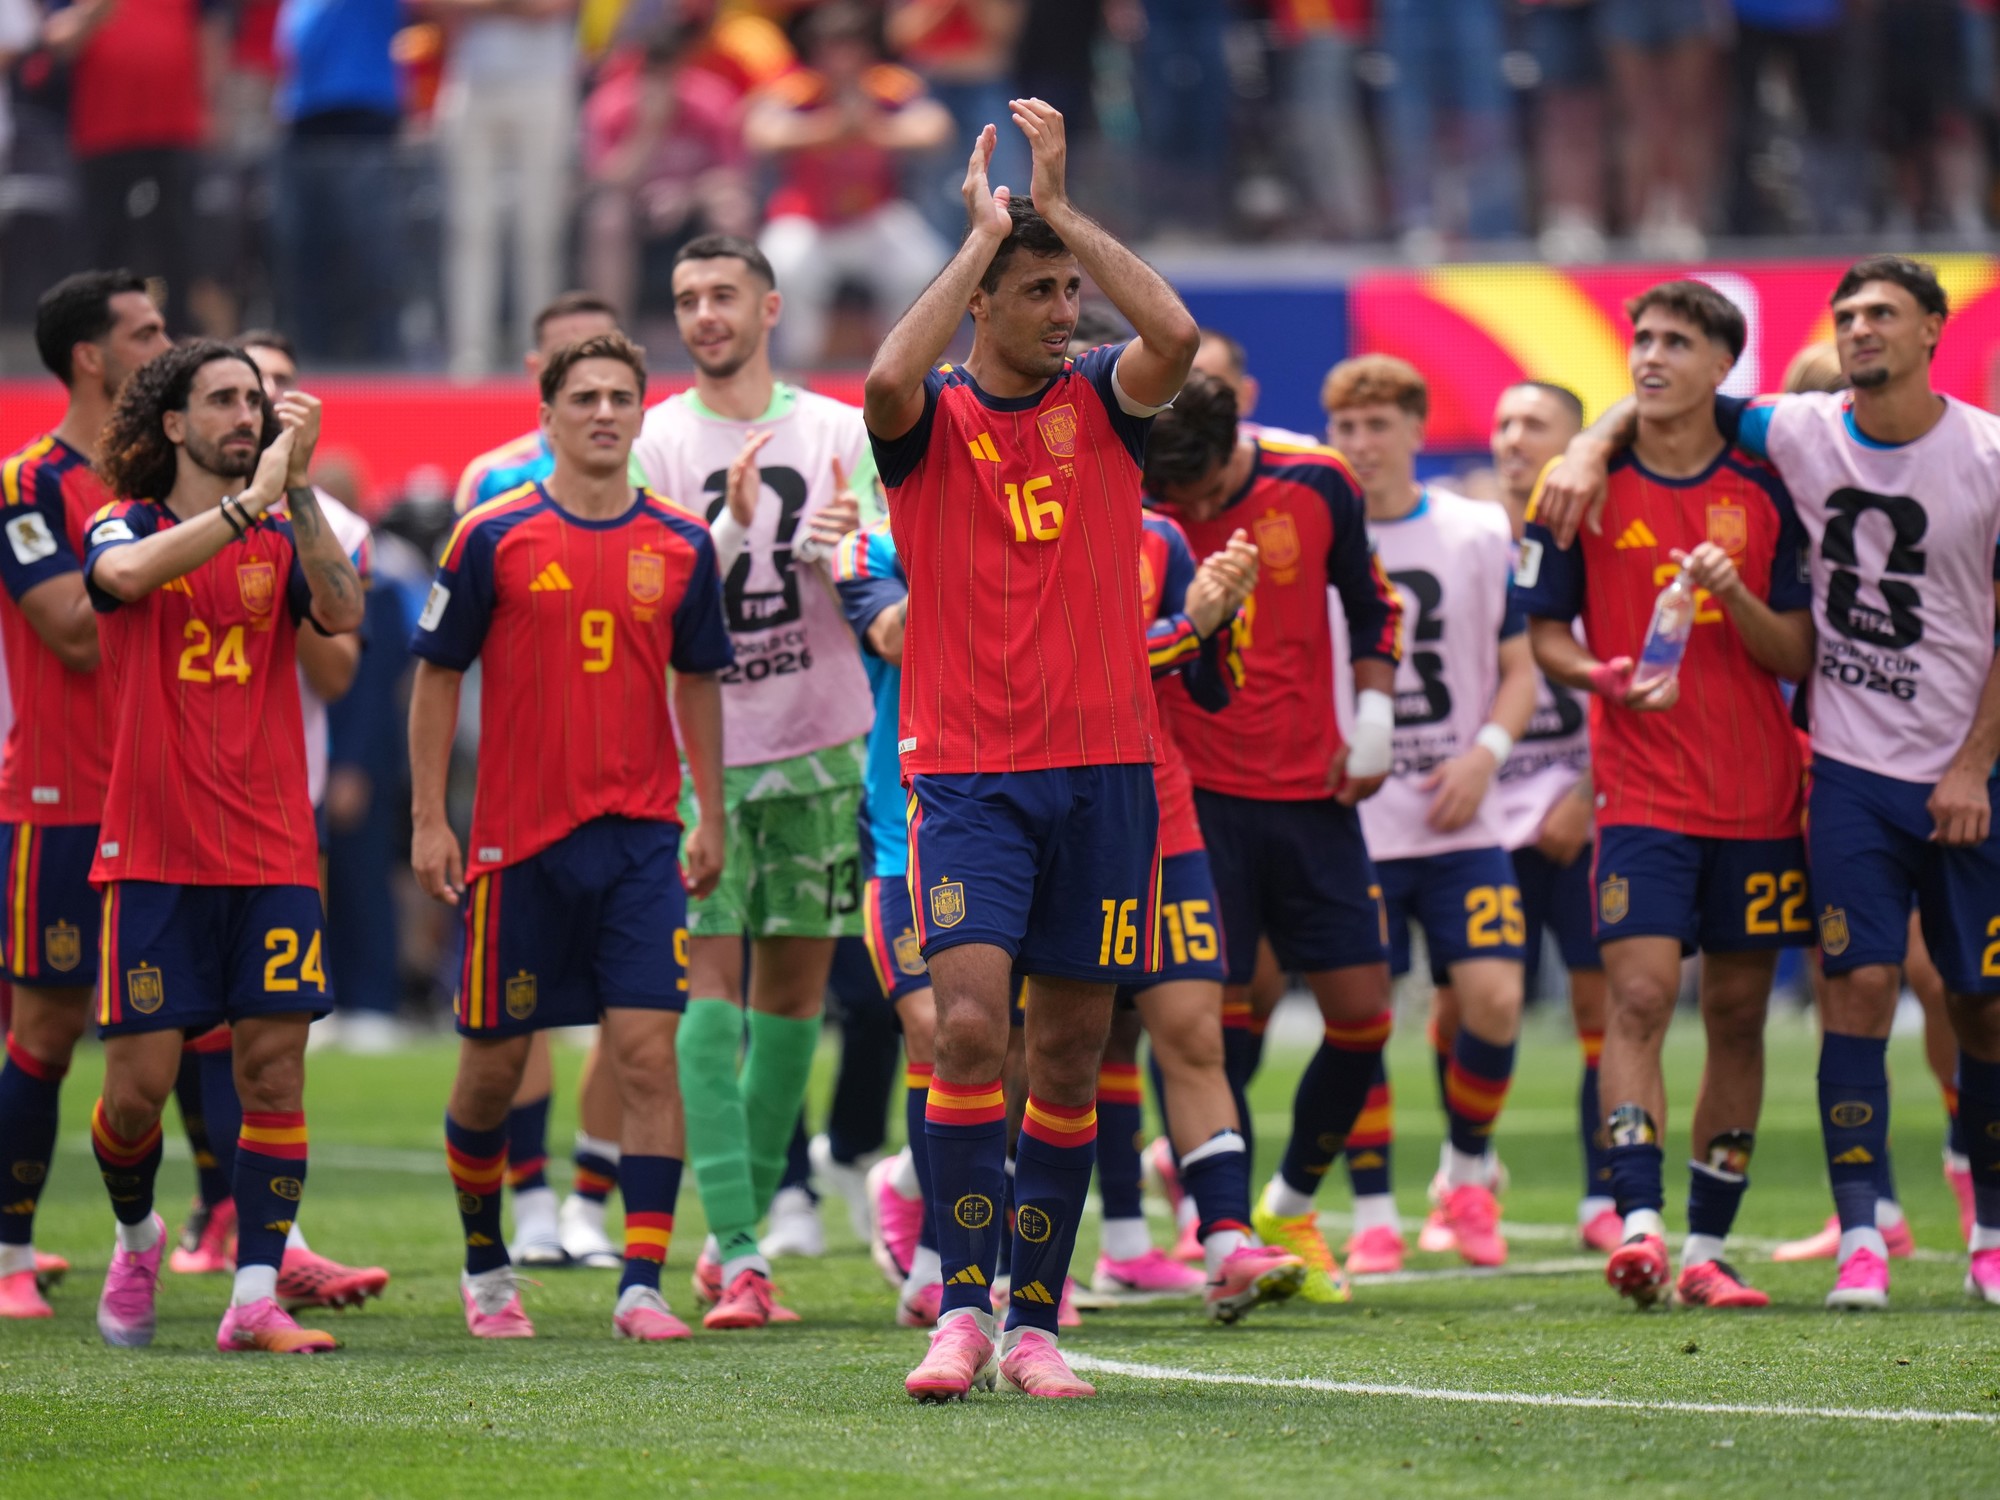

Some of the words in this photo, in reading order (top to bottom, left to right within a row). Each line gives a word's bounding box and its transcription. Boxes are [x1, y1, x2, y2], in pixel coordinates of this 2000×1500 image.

[1004, 475, 1064, 542] 16
[178, 618, 252, 685] 24
[580, 609, 615, 673] 9
[1847, 608, 1897, 637] FIFA
[1821, 655, 1918, 701] 2026
[1883, 655, 1922, 674] CUP
[826, 856, 859, 919] 13
[1465, 884, 1526, 948] 25
[1745, 869, 1811, 935] 22
[263, 927, 326, 993] 24
[1099, 898, 1138, 966] 16
[1162, 899, 1219, 965] 15
[963, 1202, 985, 1211] RF
[963, 1212, 984, 1221] EF
